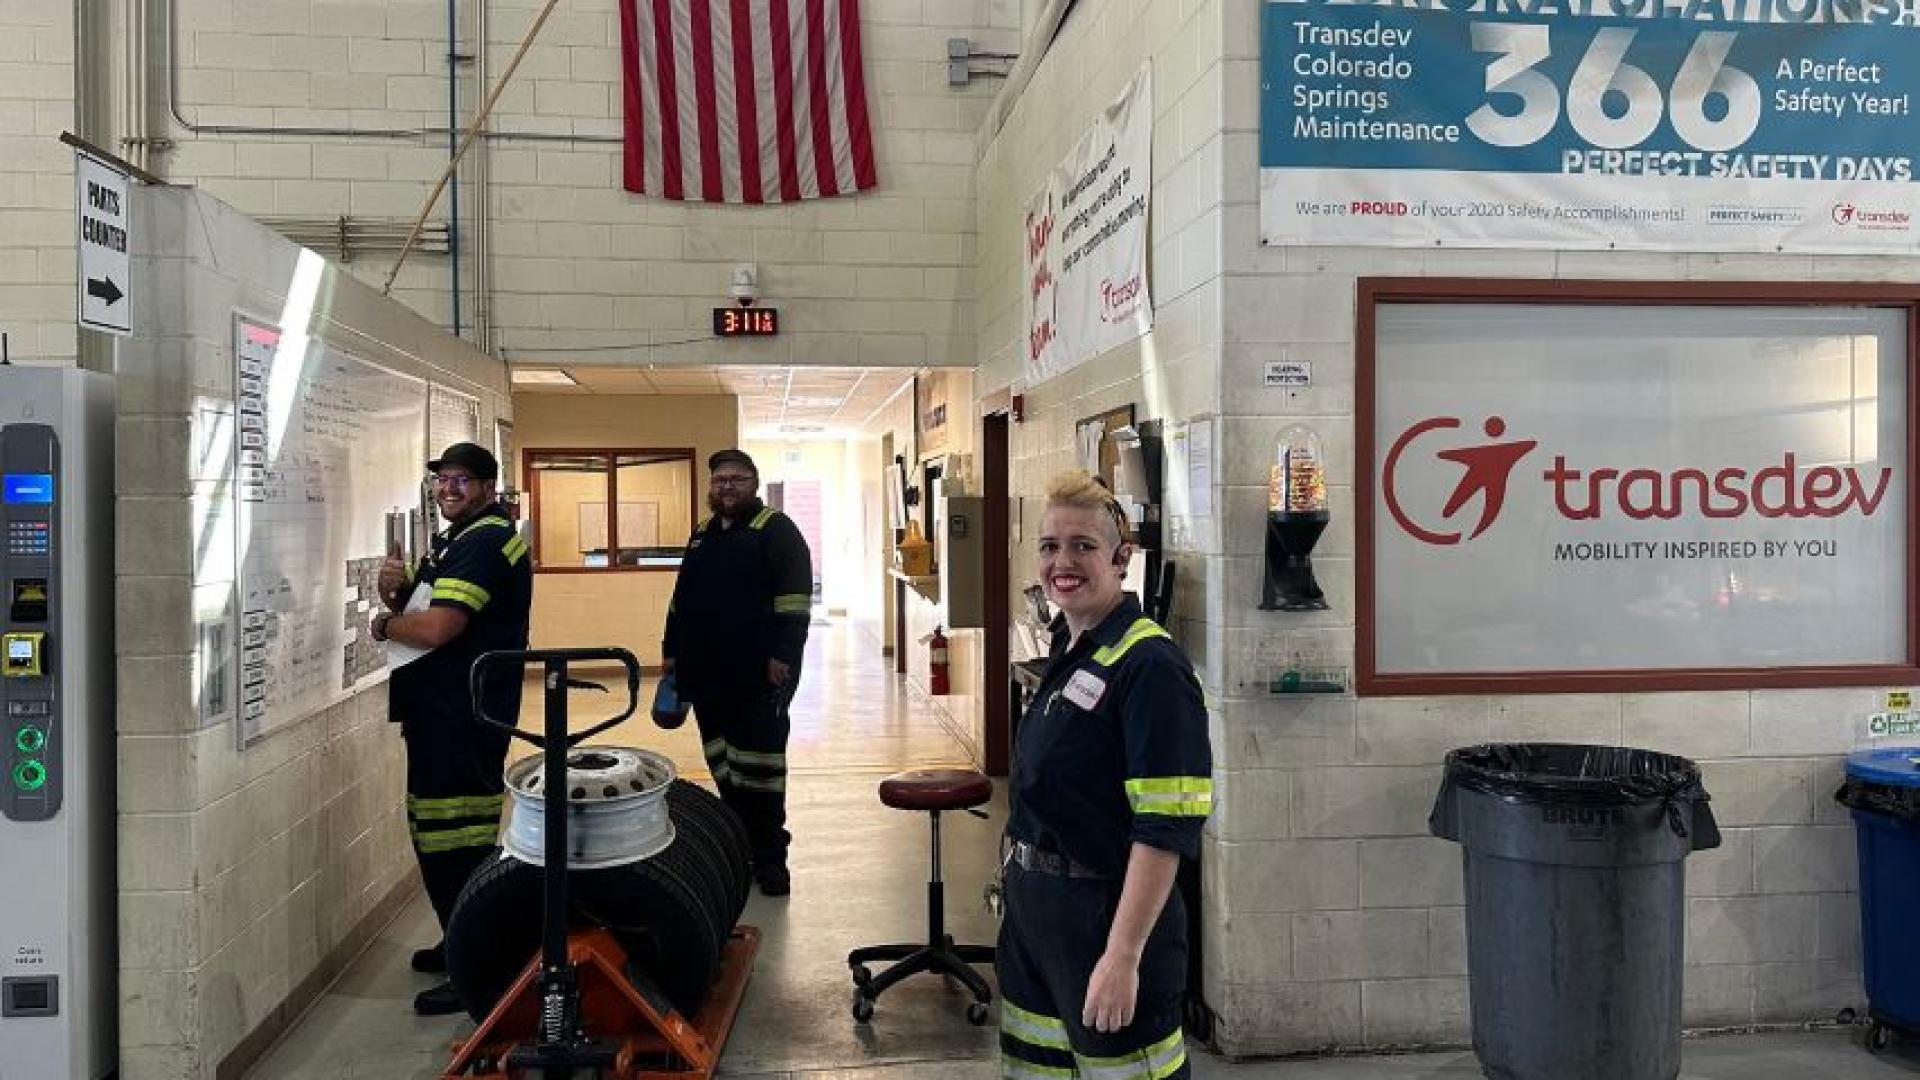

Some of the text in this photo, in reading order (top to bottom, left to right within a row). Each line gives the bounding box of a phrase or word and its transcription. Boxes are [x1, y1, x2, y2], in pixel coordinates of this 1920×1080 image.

[1292, 20, 1412, 47] Transdev
[1293, 51, 1412, 80] Colorado
[1775, 58, 1880, 83] A Perfect
[1293, 83, 1389, 114] Springs
[1465, 22, 1761, 153] 366
[1775, 87, 1909, 118] Safety Year!
[1293, 114, 1460, 143] Maintenance
[1562, 150, 1913, 181] PERFECT SAFETY DAYS
[87, 179, 120, 216] PARTS
[1296, 201, 1685, 222] We are PROUD of your 2020 Safety Accomplishments!
[82, 215, 127, 253] COUNTER
[1544, 452, 1892, 520] transdev
[1555, 539, 1838, 561] MOBILITY INSPIRED BY YOU
